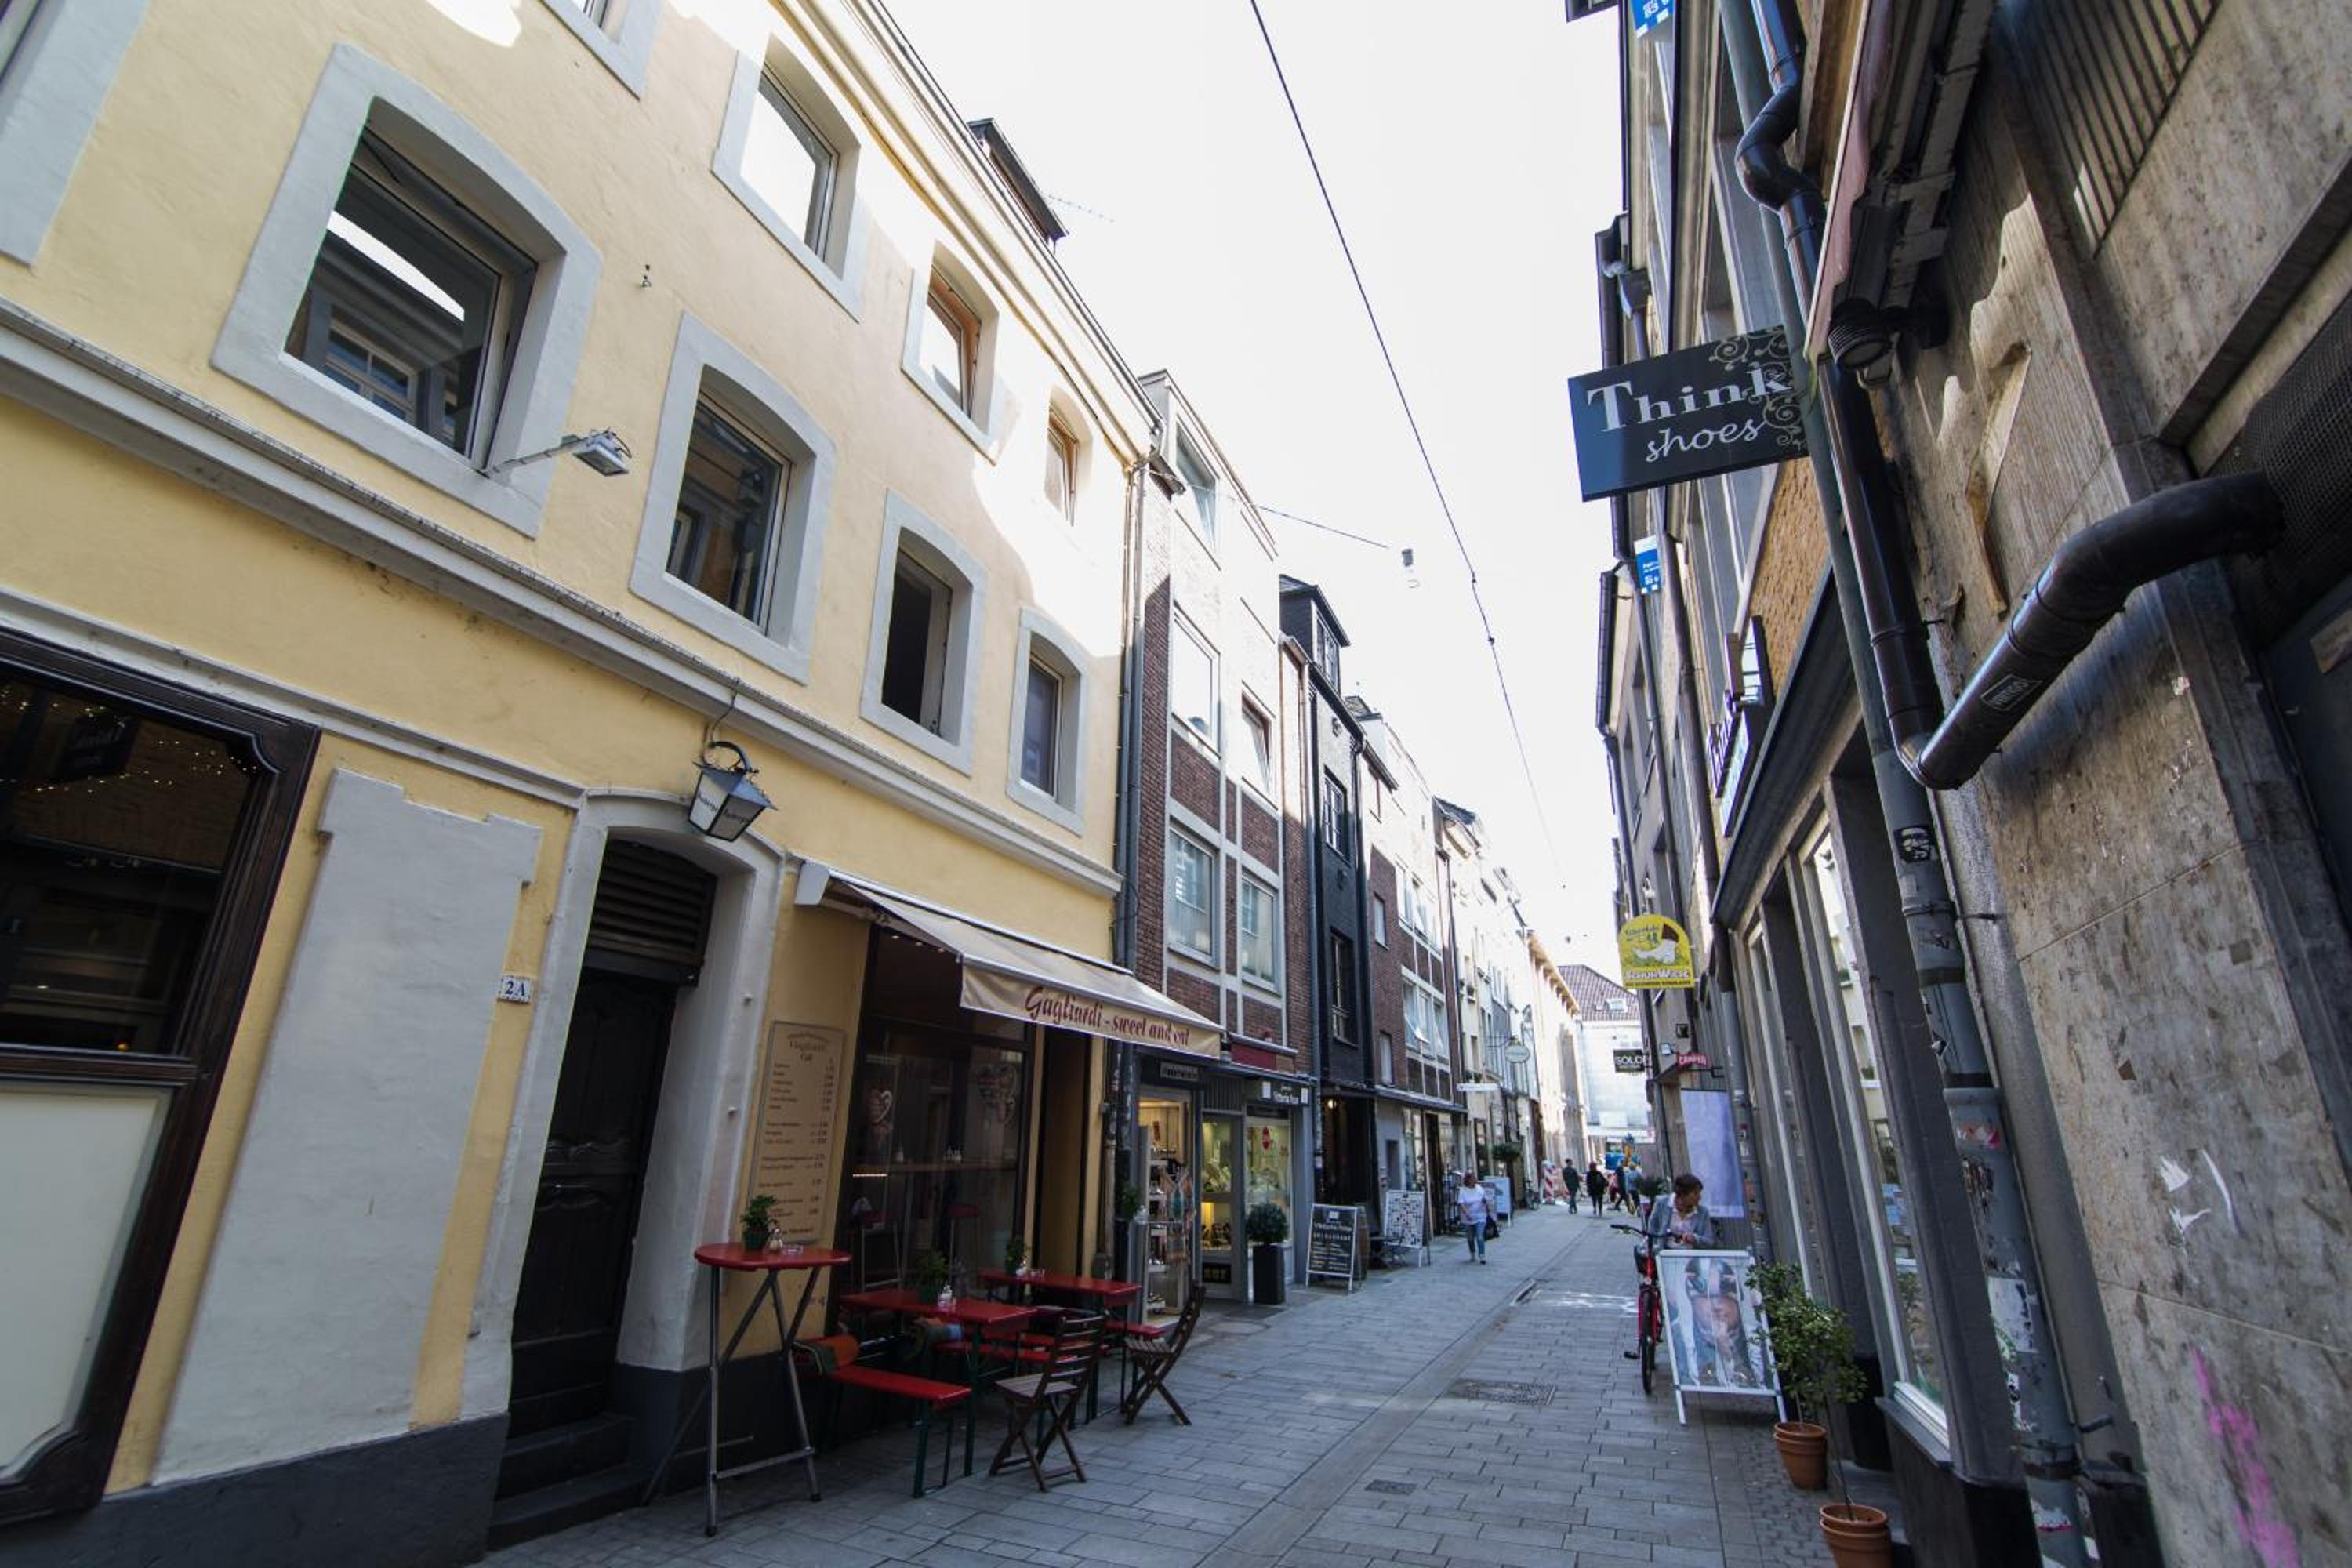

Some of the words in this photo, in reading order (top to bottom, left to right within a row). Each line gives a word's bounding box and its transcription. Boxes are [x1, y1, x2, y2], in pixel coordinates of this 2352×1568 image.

[1588, 367, 1792, 431] Think
[1646, 419, 1764, 462] shoes
[505, 981, 524, 996] 2A
[1025, 986, 1103, 1029] Gagliardi
[1112, 1015, 1146, 1036] sweet
[1149, 1022, 1172, 1042] and
